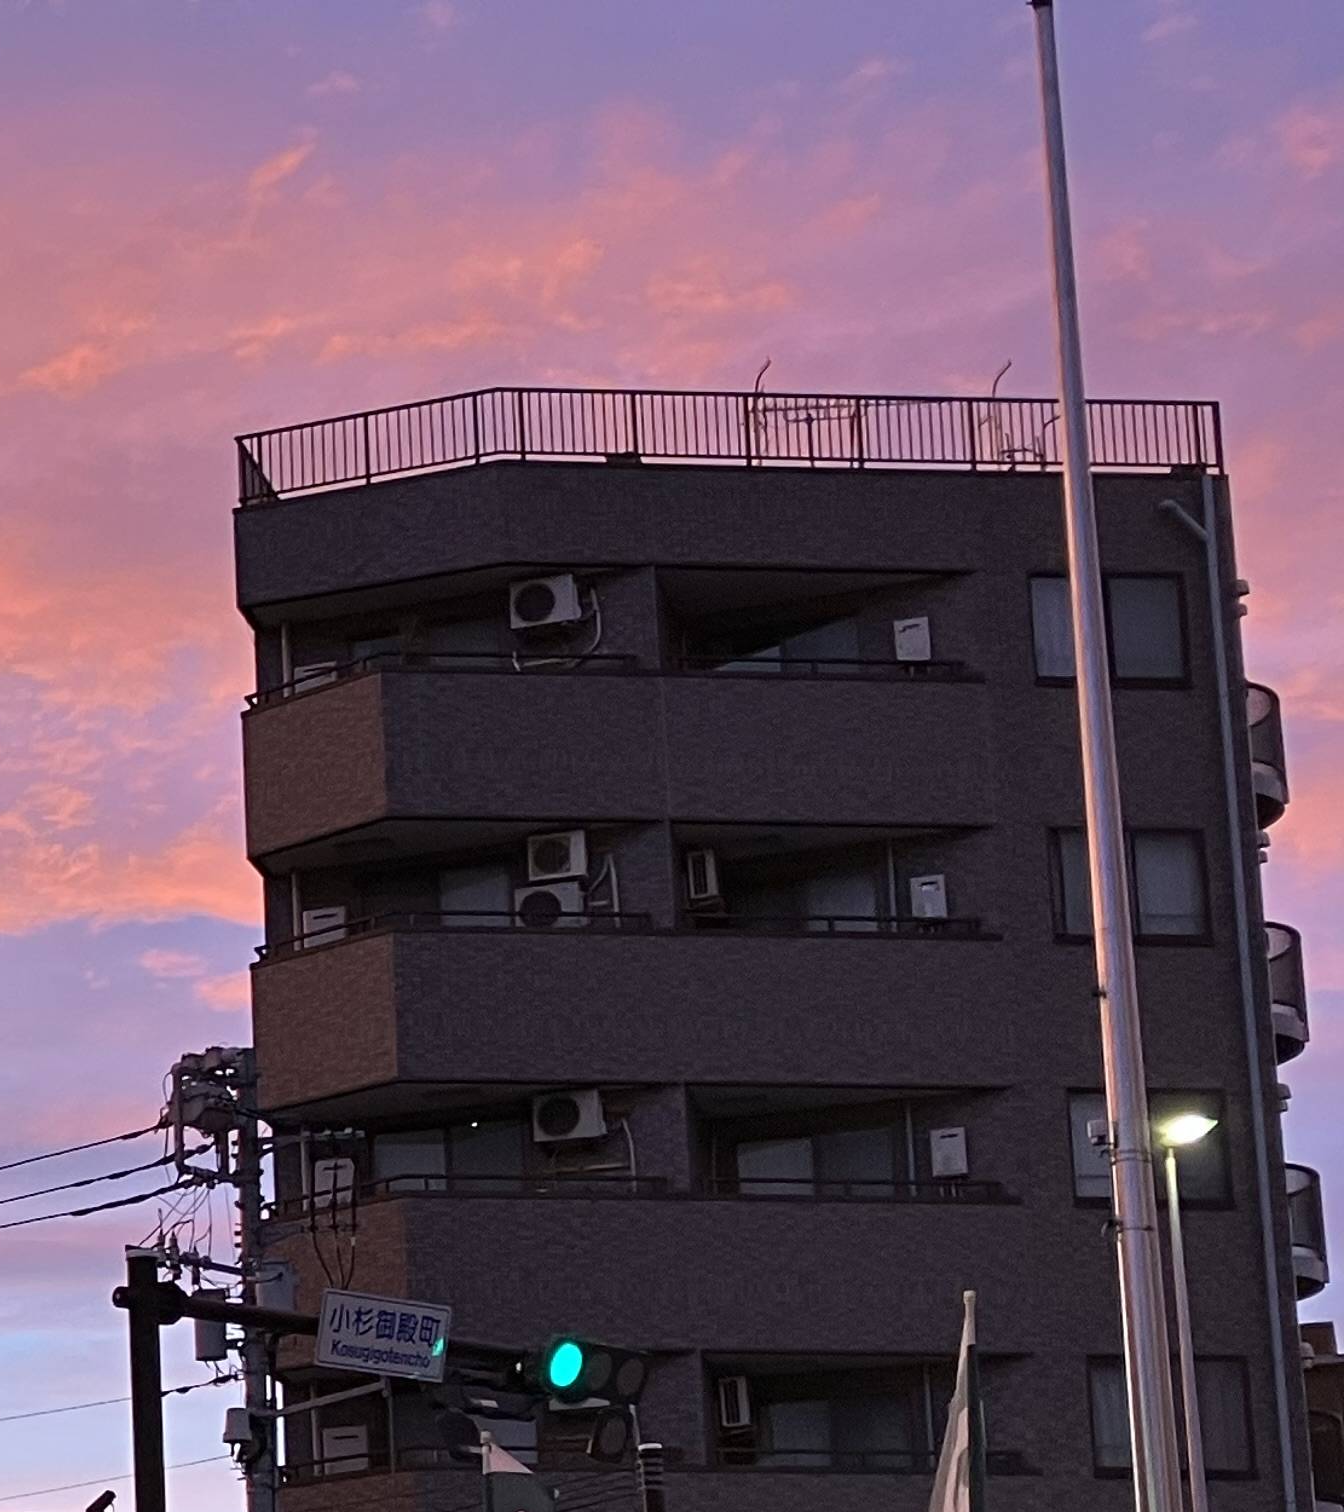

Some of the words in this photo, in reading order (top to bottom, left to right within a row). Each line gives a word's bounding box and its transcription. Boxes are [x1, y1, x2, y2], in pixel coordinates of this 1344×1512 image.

[329, 1303, 441, 1348] 小杉御殿町
[330, 1339, 431, 1369] Kosugigotencho
